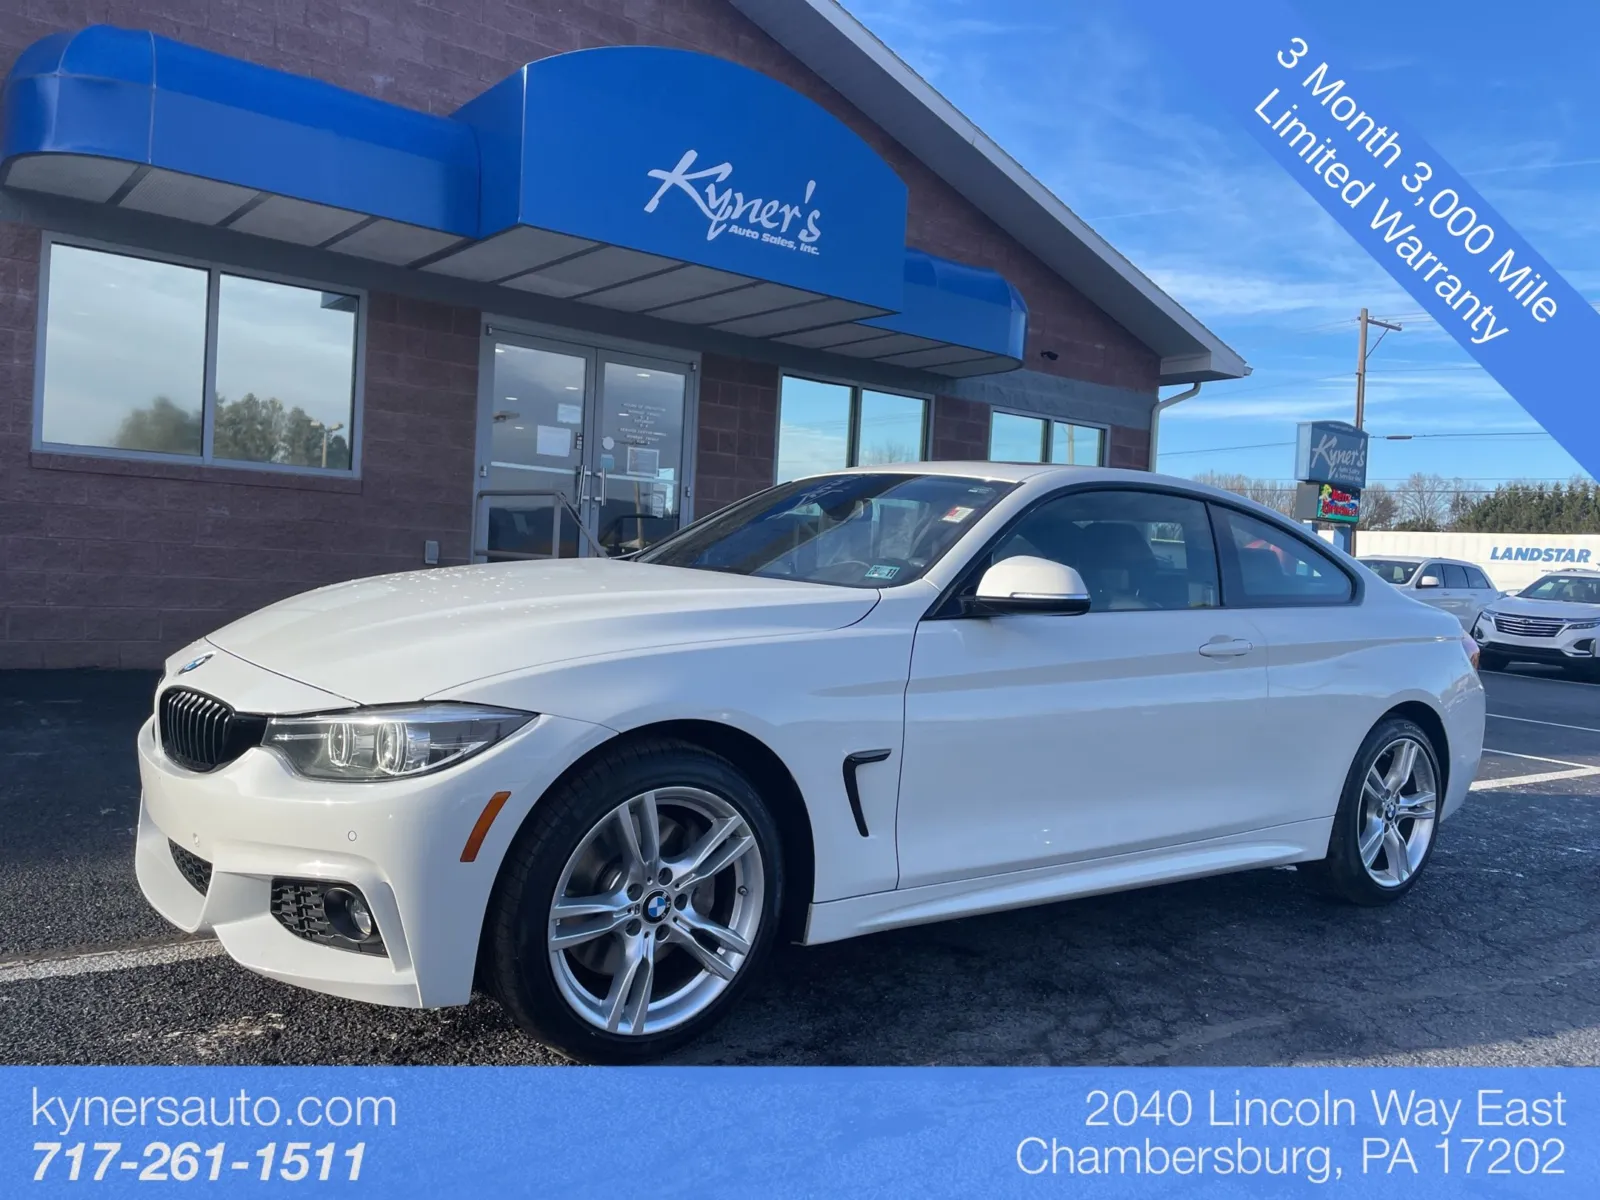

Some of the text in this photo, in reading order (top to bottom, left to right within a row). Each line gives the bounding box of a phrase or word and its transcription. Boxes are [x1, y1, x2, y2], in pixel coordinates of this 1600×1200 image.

[644, 149, 821, 241] Kyner's
[728, 225, 820, 256] Auto Sales, Inc.
[1311, 434, 1365, 480] Kyner's
[1331, 489, 1353, 503] Merry
[1490, 547, 1592, 563] LANDSTAR
